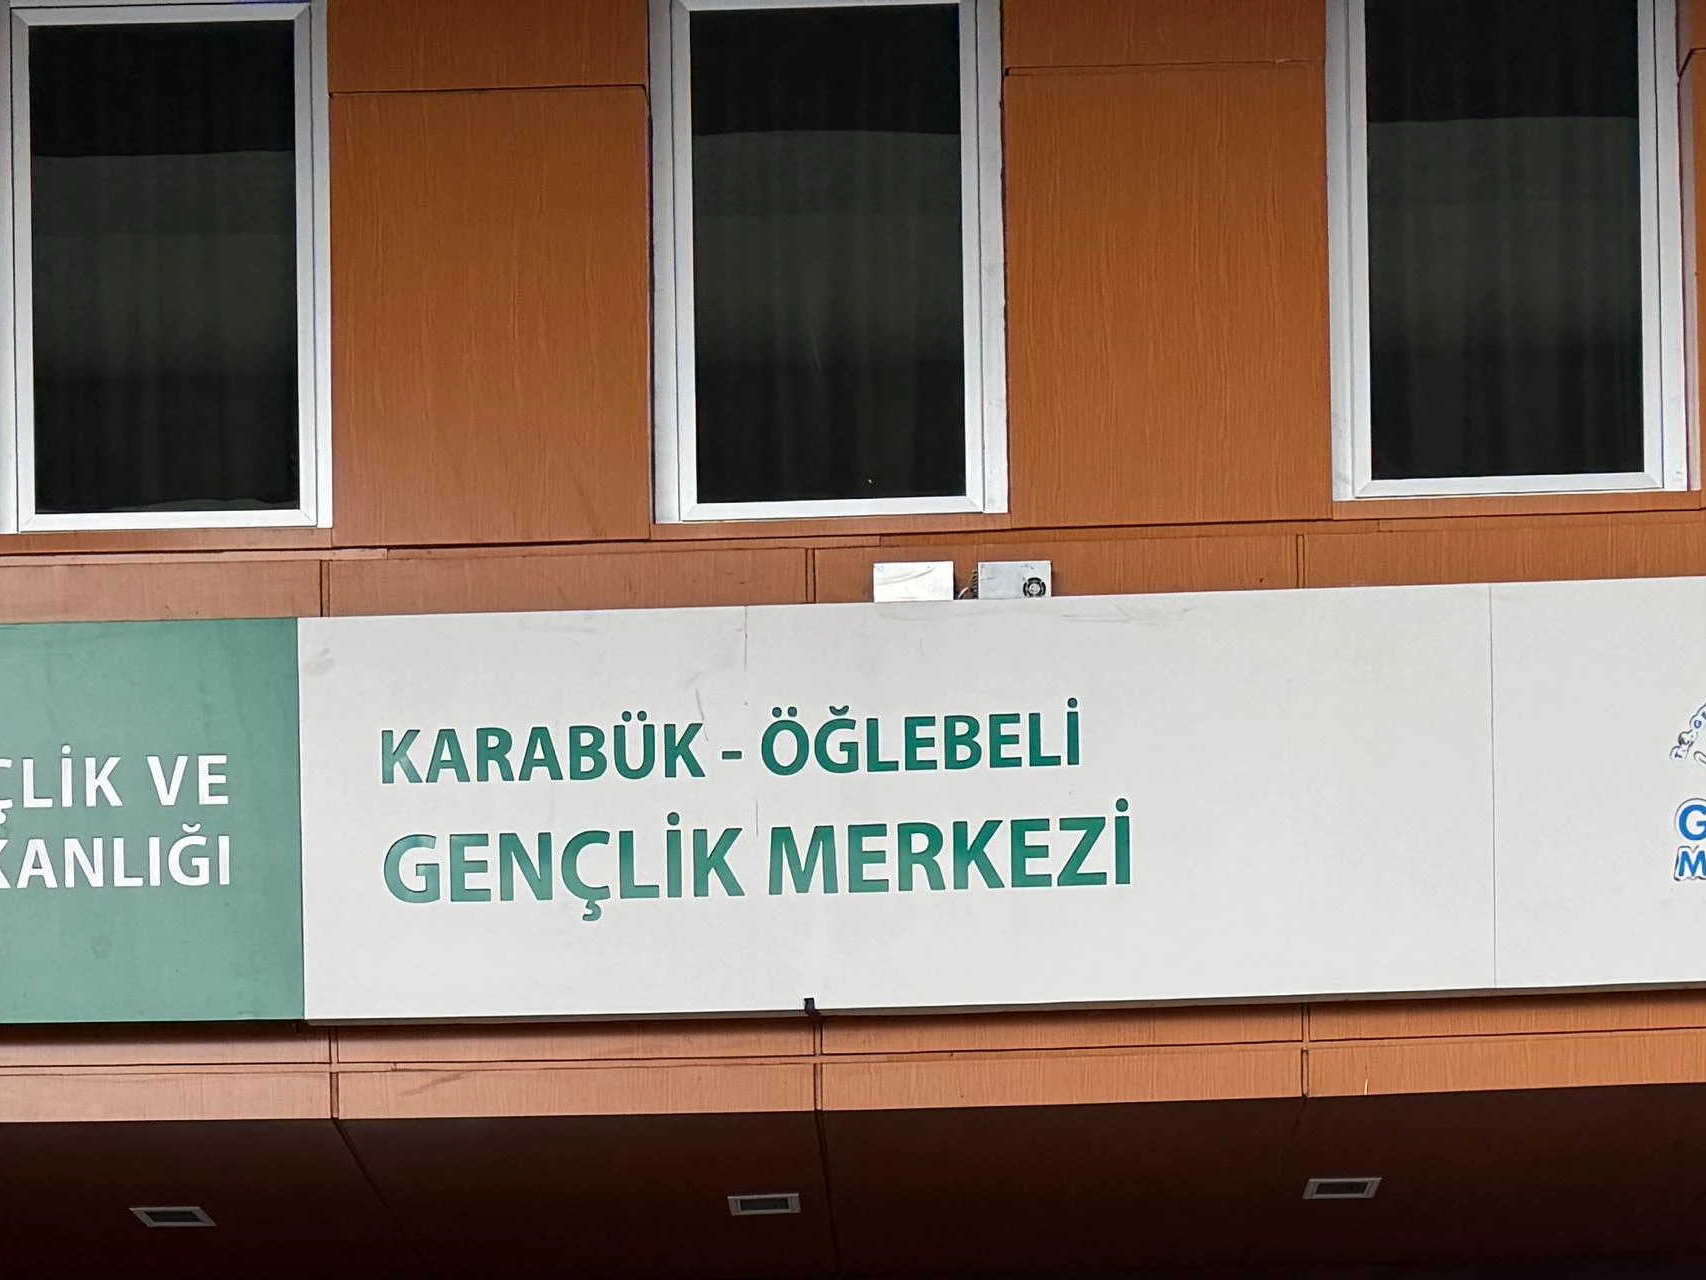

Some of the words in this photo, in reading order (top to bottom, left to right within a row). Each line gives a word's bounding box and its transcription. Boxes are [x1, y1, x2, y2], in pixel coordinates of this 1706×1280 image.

[152, 752, 230, 807] VE
[380, 710, 706, 785] KARABÜK
[759, 697, 1081, 777] ÖĞLEBELİ
[383, 810, 745, 921] GENÇLİK
[768, 797, 1131, 896] MERKEZİ
